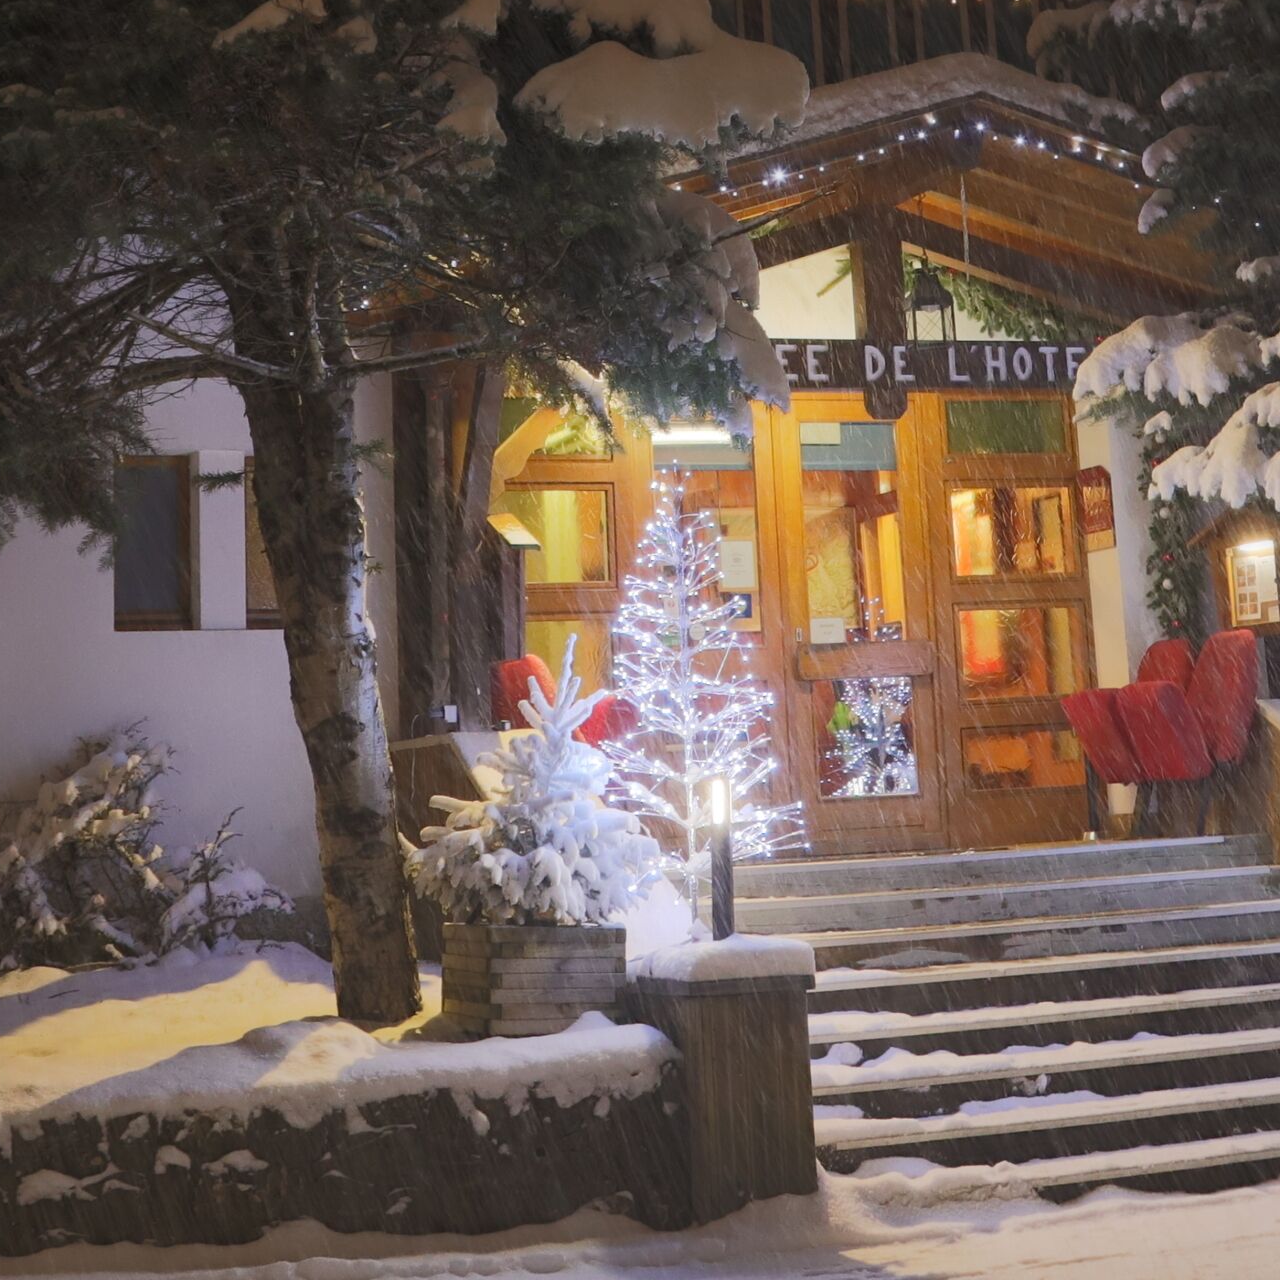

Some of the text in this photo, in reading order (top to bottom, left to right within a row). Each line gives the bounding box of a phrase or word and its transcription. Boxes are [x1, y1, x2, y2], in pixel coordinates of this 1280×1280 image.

[774, 343, 1086, 383] EE DE L'HOTE
